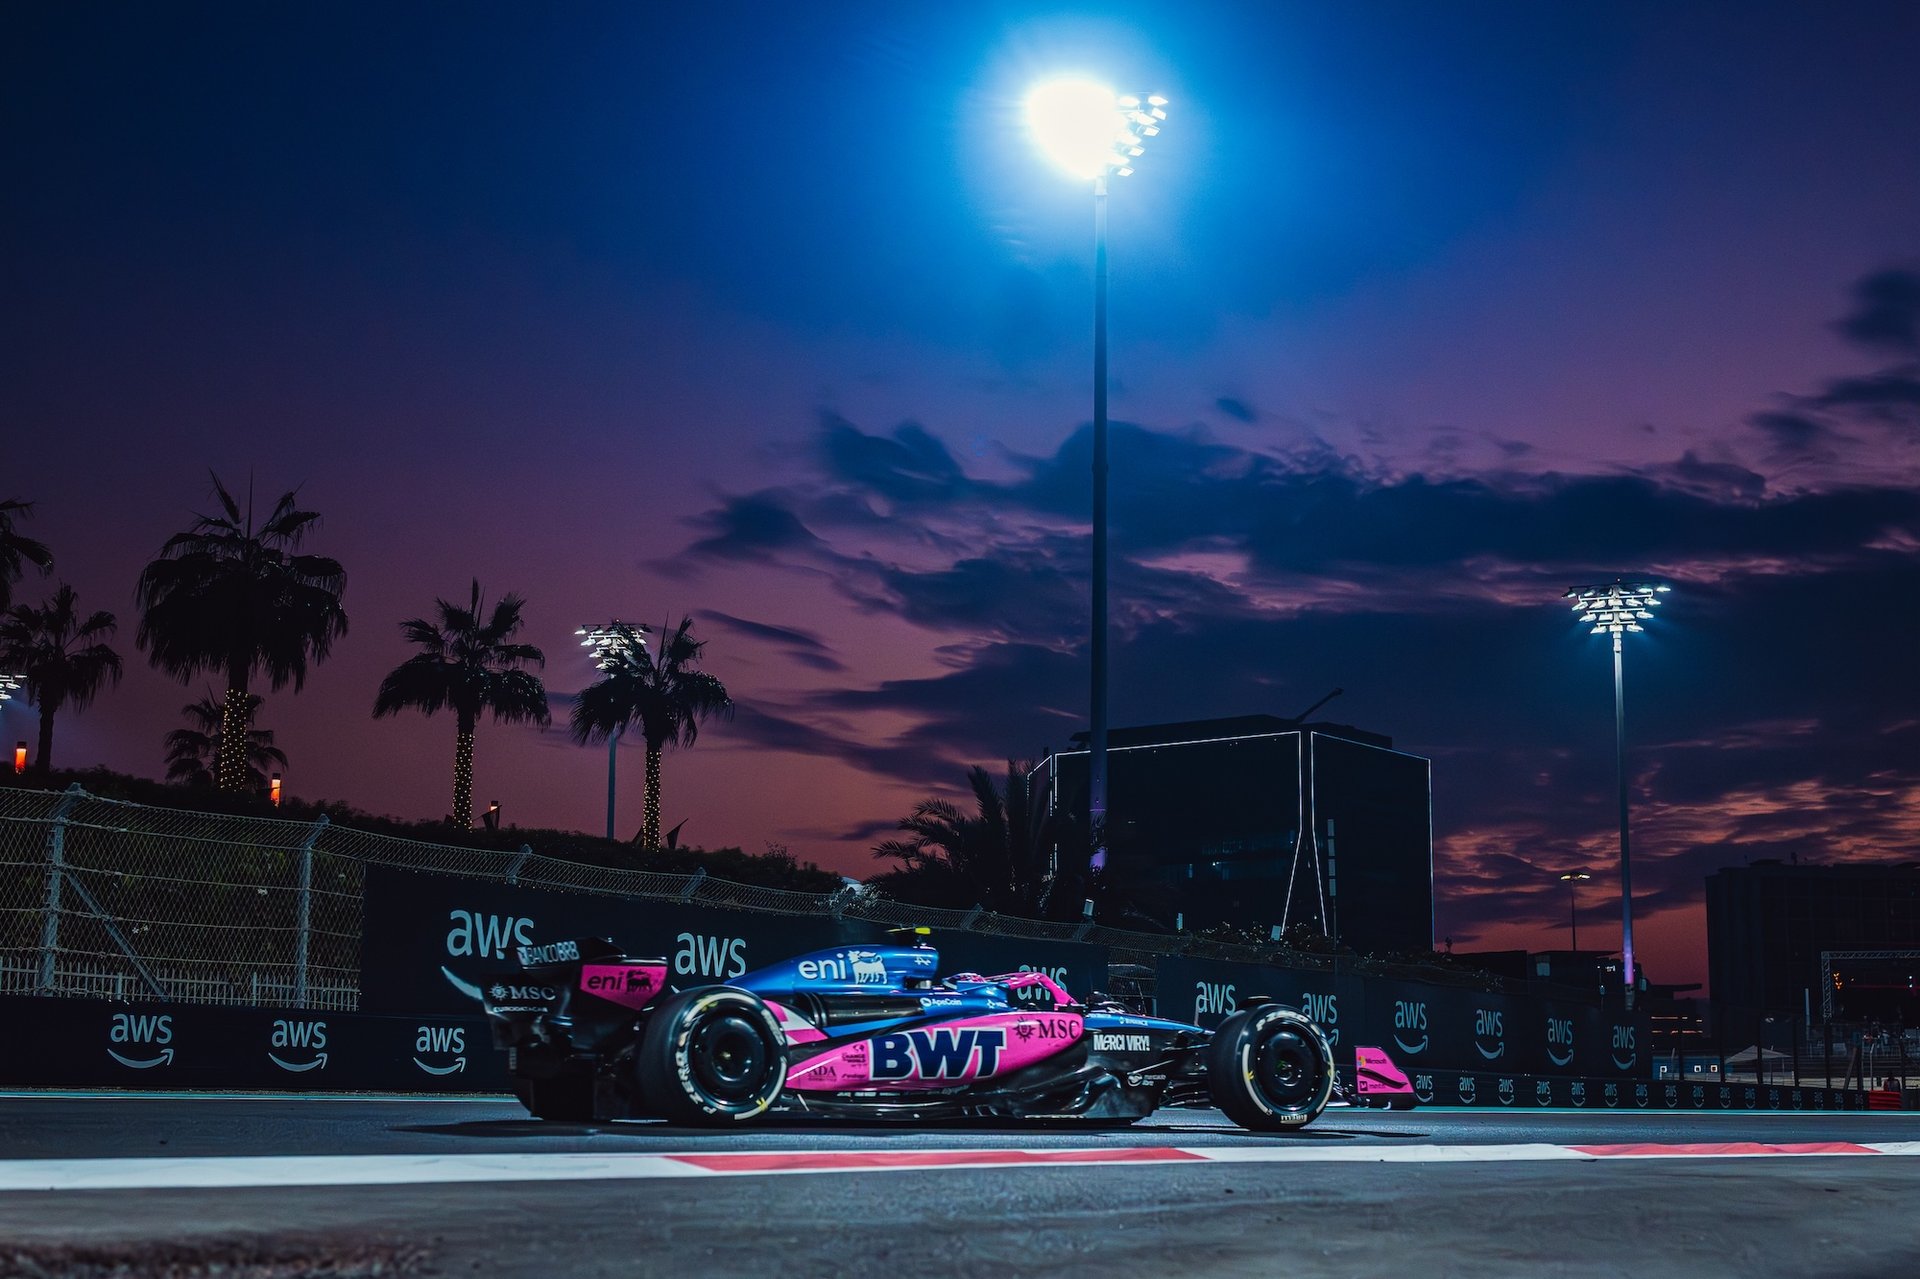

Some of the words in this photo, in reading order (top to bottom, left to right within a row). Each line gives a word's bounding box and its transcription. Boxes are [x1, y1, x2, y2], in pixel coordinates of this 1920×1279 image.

[447, 910, 535, 960] aws
[675, 932, 747, 979] aws
[799, 953, 847, 980] eni
[508, 986, 556, 1001] MSC
[587, 971, 623, 990] eni
[1195, 981, 1237, 1015] aws
[1302, 993, 1338, 1025] aws
[110, 1014, 173, 1045] aws
[1036, 1019, 1080, 1039] MSC
[1395, 1001, 1428, 1031] aws
[1475, 1008, 1504, 1038] aws
[271, 1020, 327, 1049] aws
[416, 1026, 466, 1053] aws
[1125, 1035, 1151, 1051] VIRY!
[1547, 1018, 1574, 1046] aws
[1612, 1024, 1636, 1050] aws
[868, 1027, 1007, 1081] BWT
[1416, 1074, 1433, 1090] aws
[1459, 1076, 1476, 1092] aws
[1498, 1078, 1514, 1094] aws
[1536, 1080, 1551, 1095] aws
